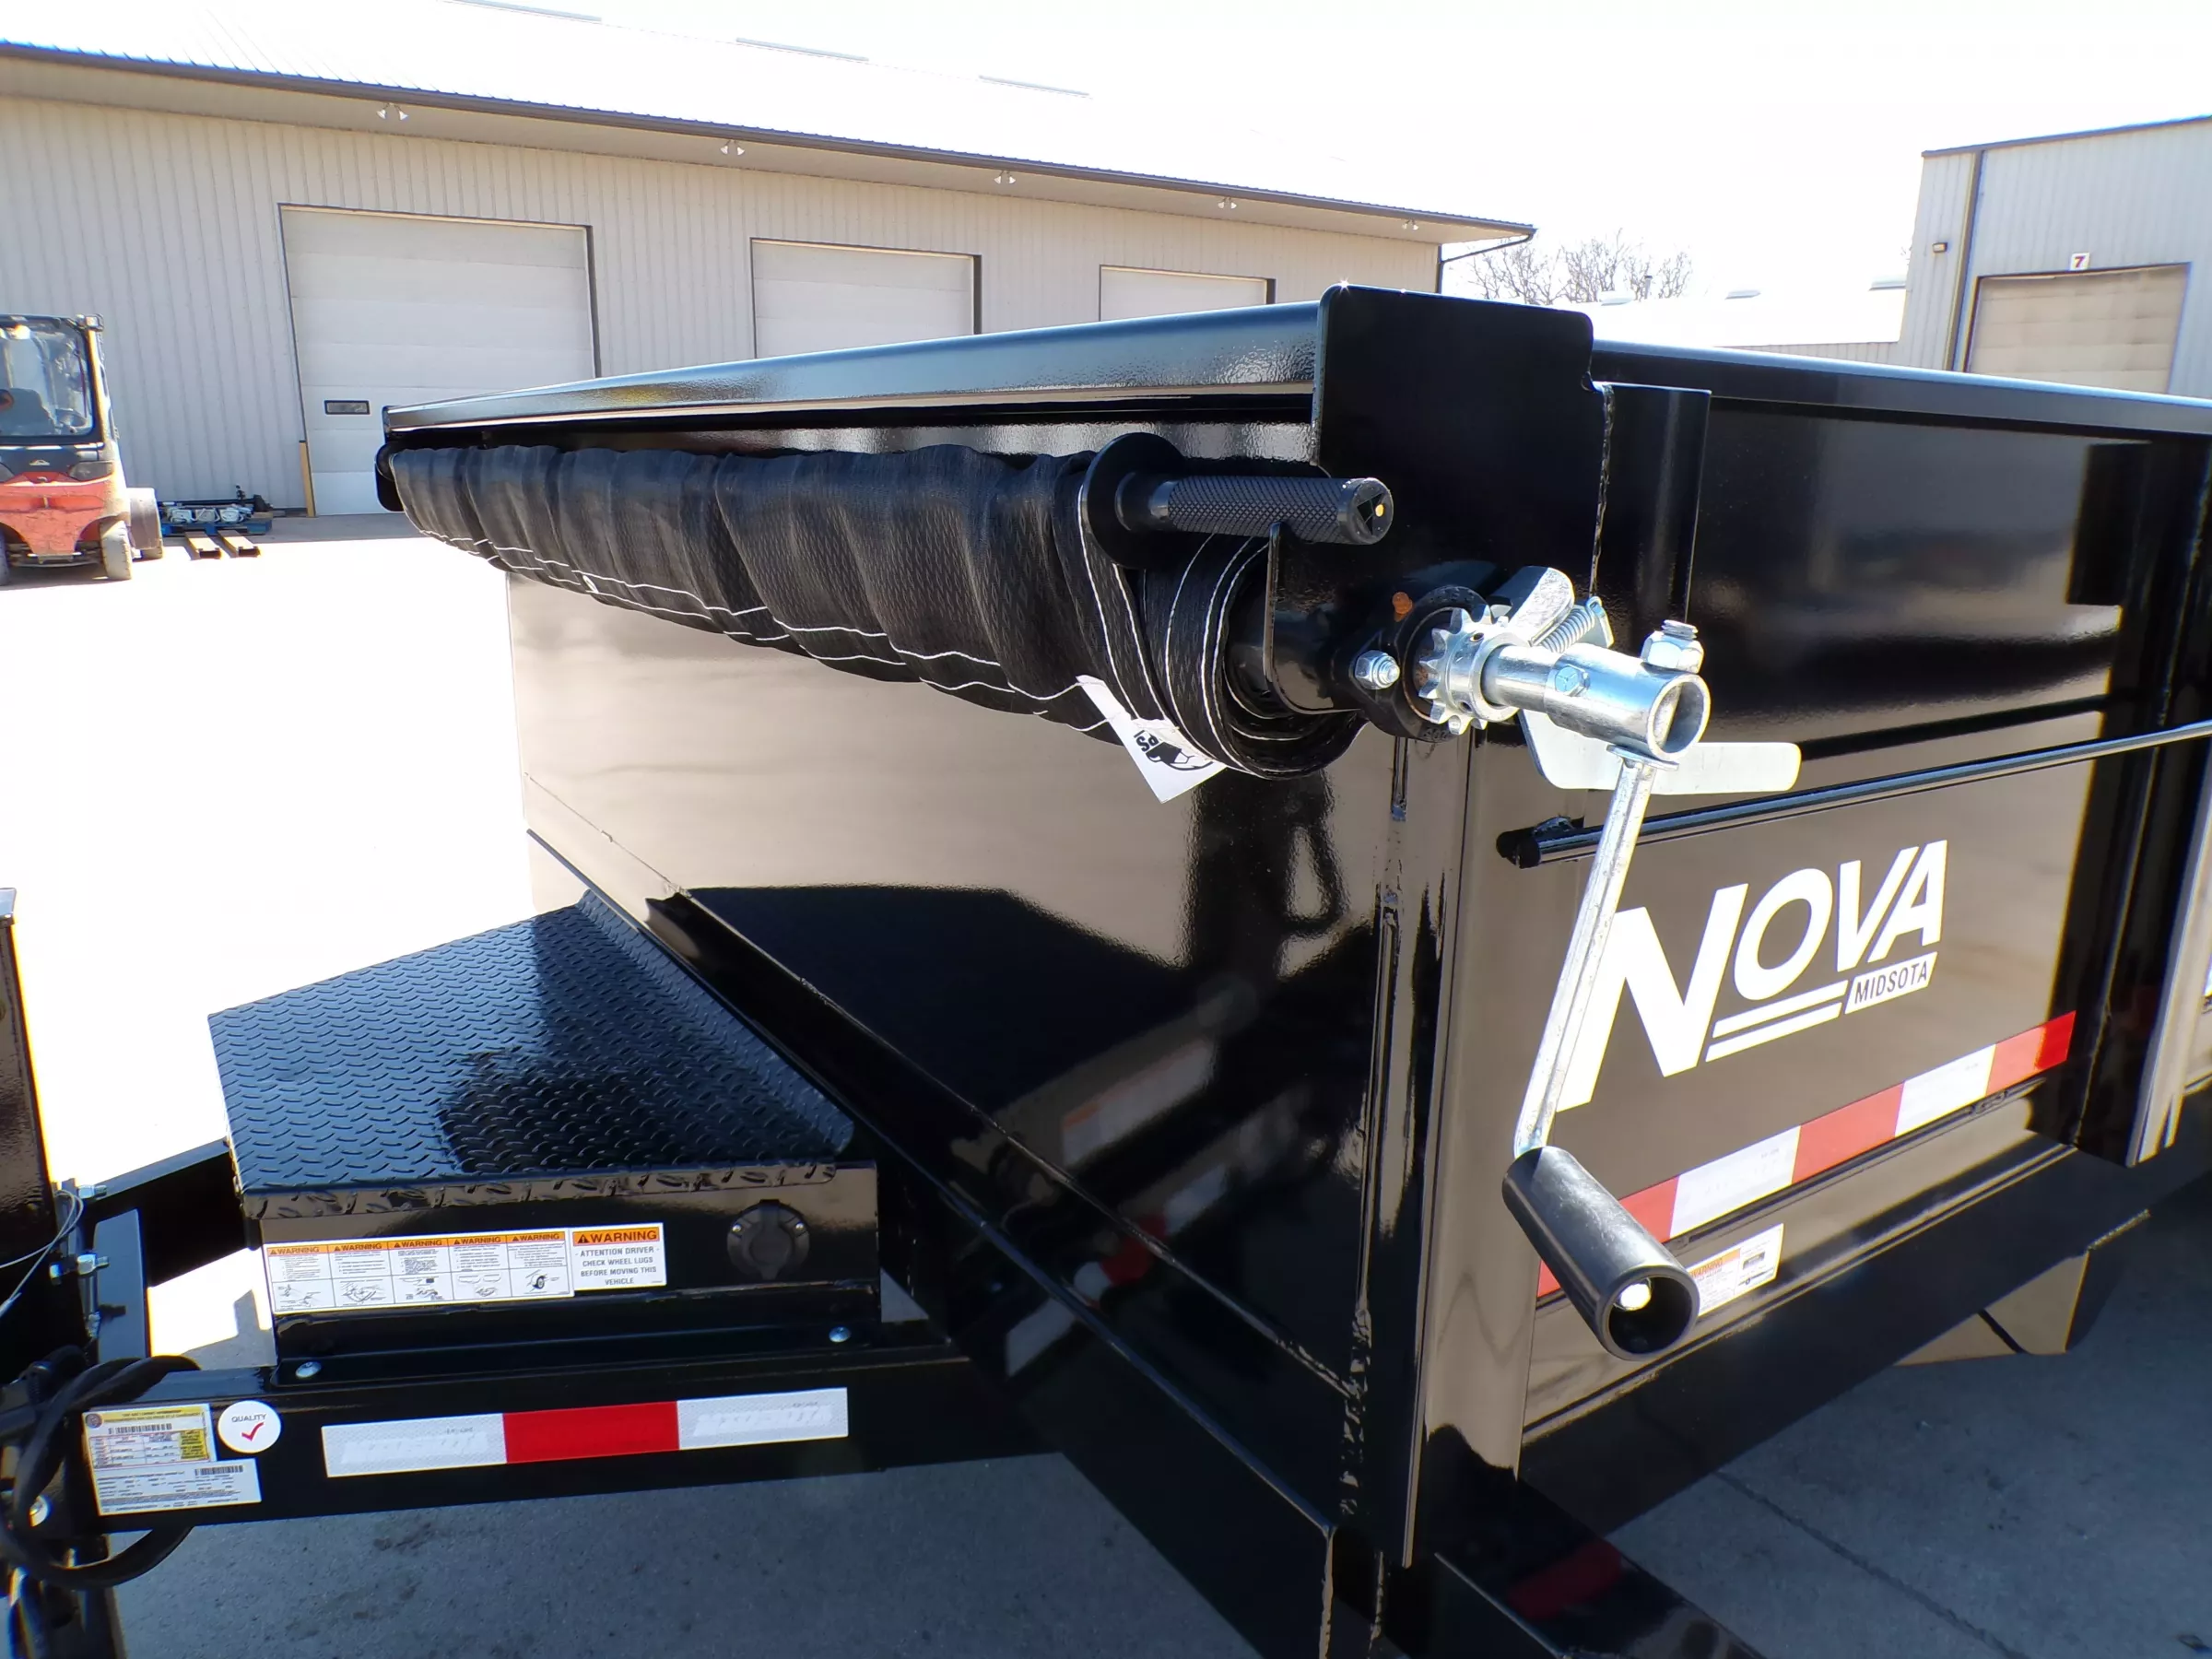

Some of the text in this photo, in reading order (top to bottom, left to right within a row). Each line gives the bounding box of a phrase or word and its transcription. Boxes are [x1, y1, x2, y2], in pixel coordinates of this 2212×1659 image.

[2075, 255, 2086, 268] 7
[1557, 840, 1947, 1112] NOVA
[1854, 960, 1927, 1005] MIDSOTA
[461, 1236, 501, 1244] WARNING
[519, 1233, 560, 1241] WARNING
[590, 1230, 657, 1243] WARNING
[340, 1242, 382, 1251] WARNING
[400, 1239, 442, 1248] WARNING
[277, 1246, 320, 1254] WARNING
[580, 1246, 654, 1257] ATTENTION DRIVER
[582, 1259, 606, 1267] CHECK
[607, 1257, 632, 1265] WHEEL
[581, 1269, 607, 1277] BEFORE
[609, 1267, 639, 1276] MOVING
[605, 1277, 634, 1286] VEHICLE
[231, 1414, 266, 1423] QUALITY
